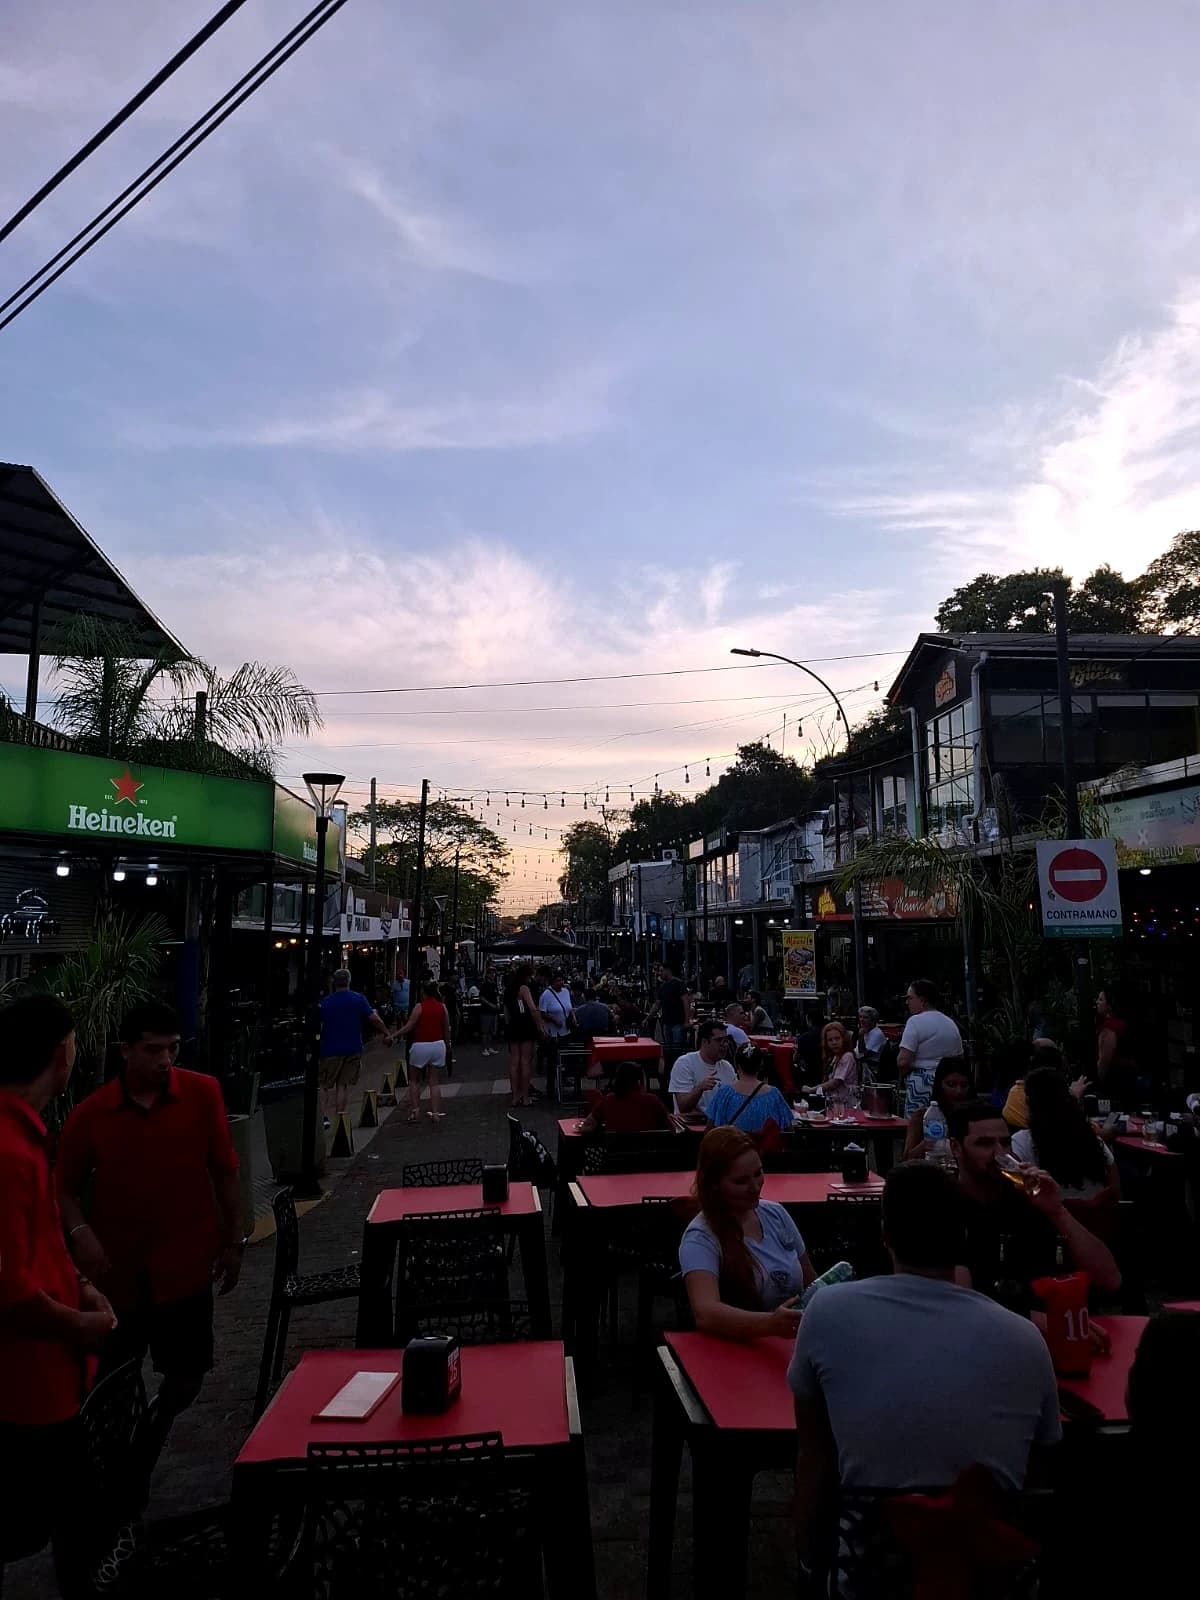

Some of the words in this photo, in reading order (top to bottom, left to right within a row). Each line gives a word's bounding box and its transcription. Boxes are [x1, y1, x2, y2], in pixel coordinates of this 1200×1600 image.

[67, 805, 177, 838] Heineken
[1046, 909, 1118, 920] CONTRAMANO
[1063, 1306, 1090, 1342] 10
